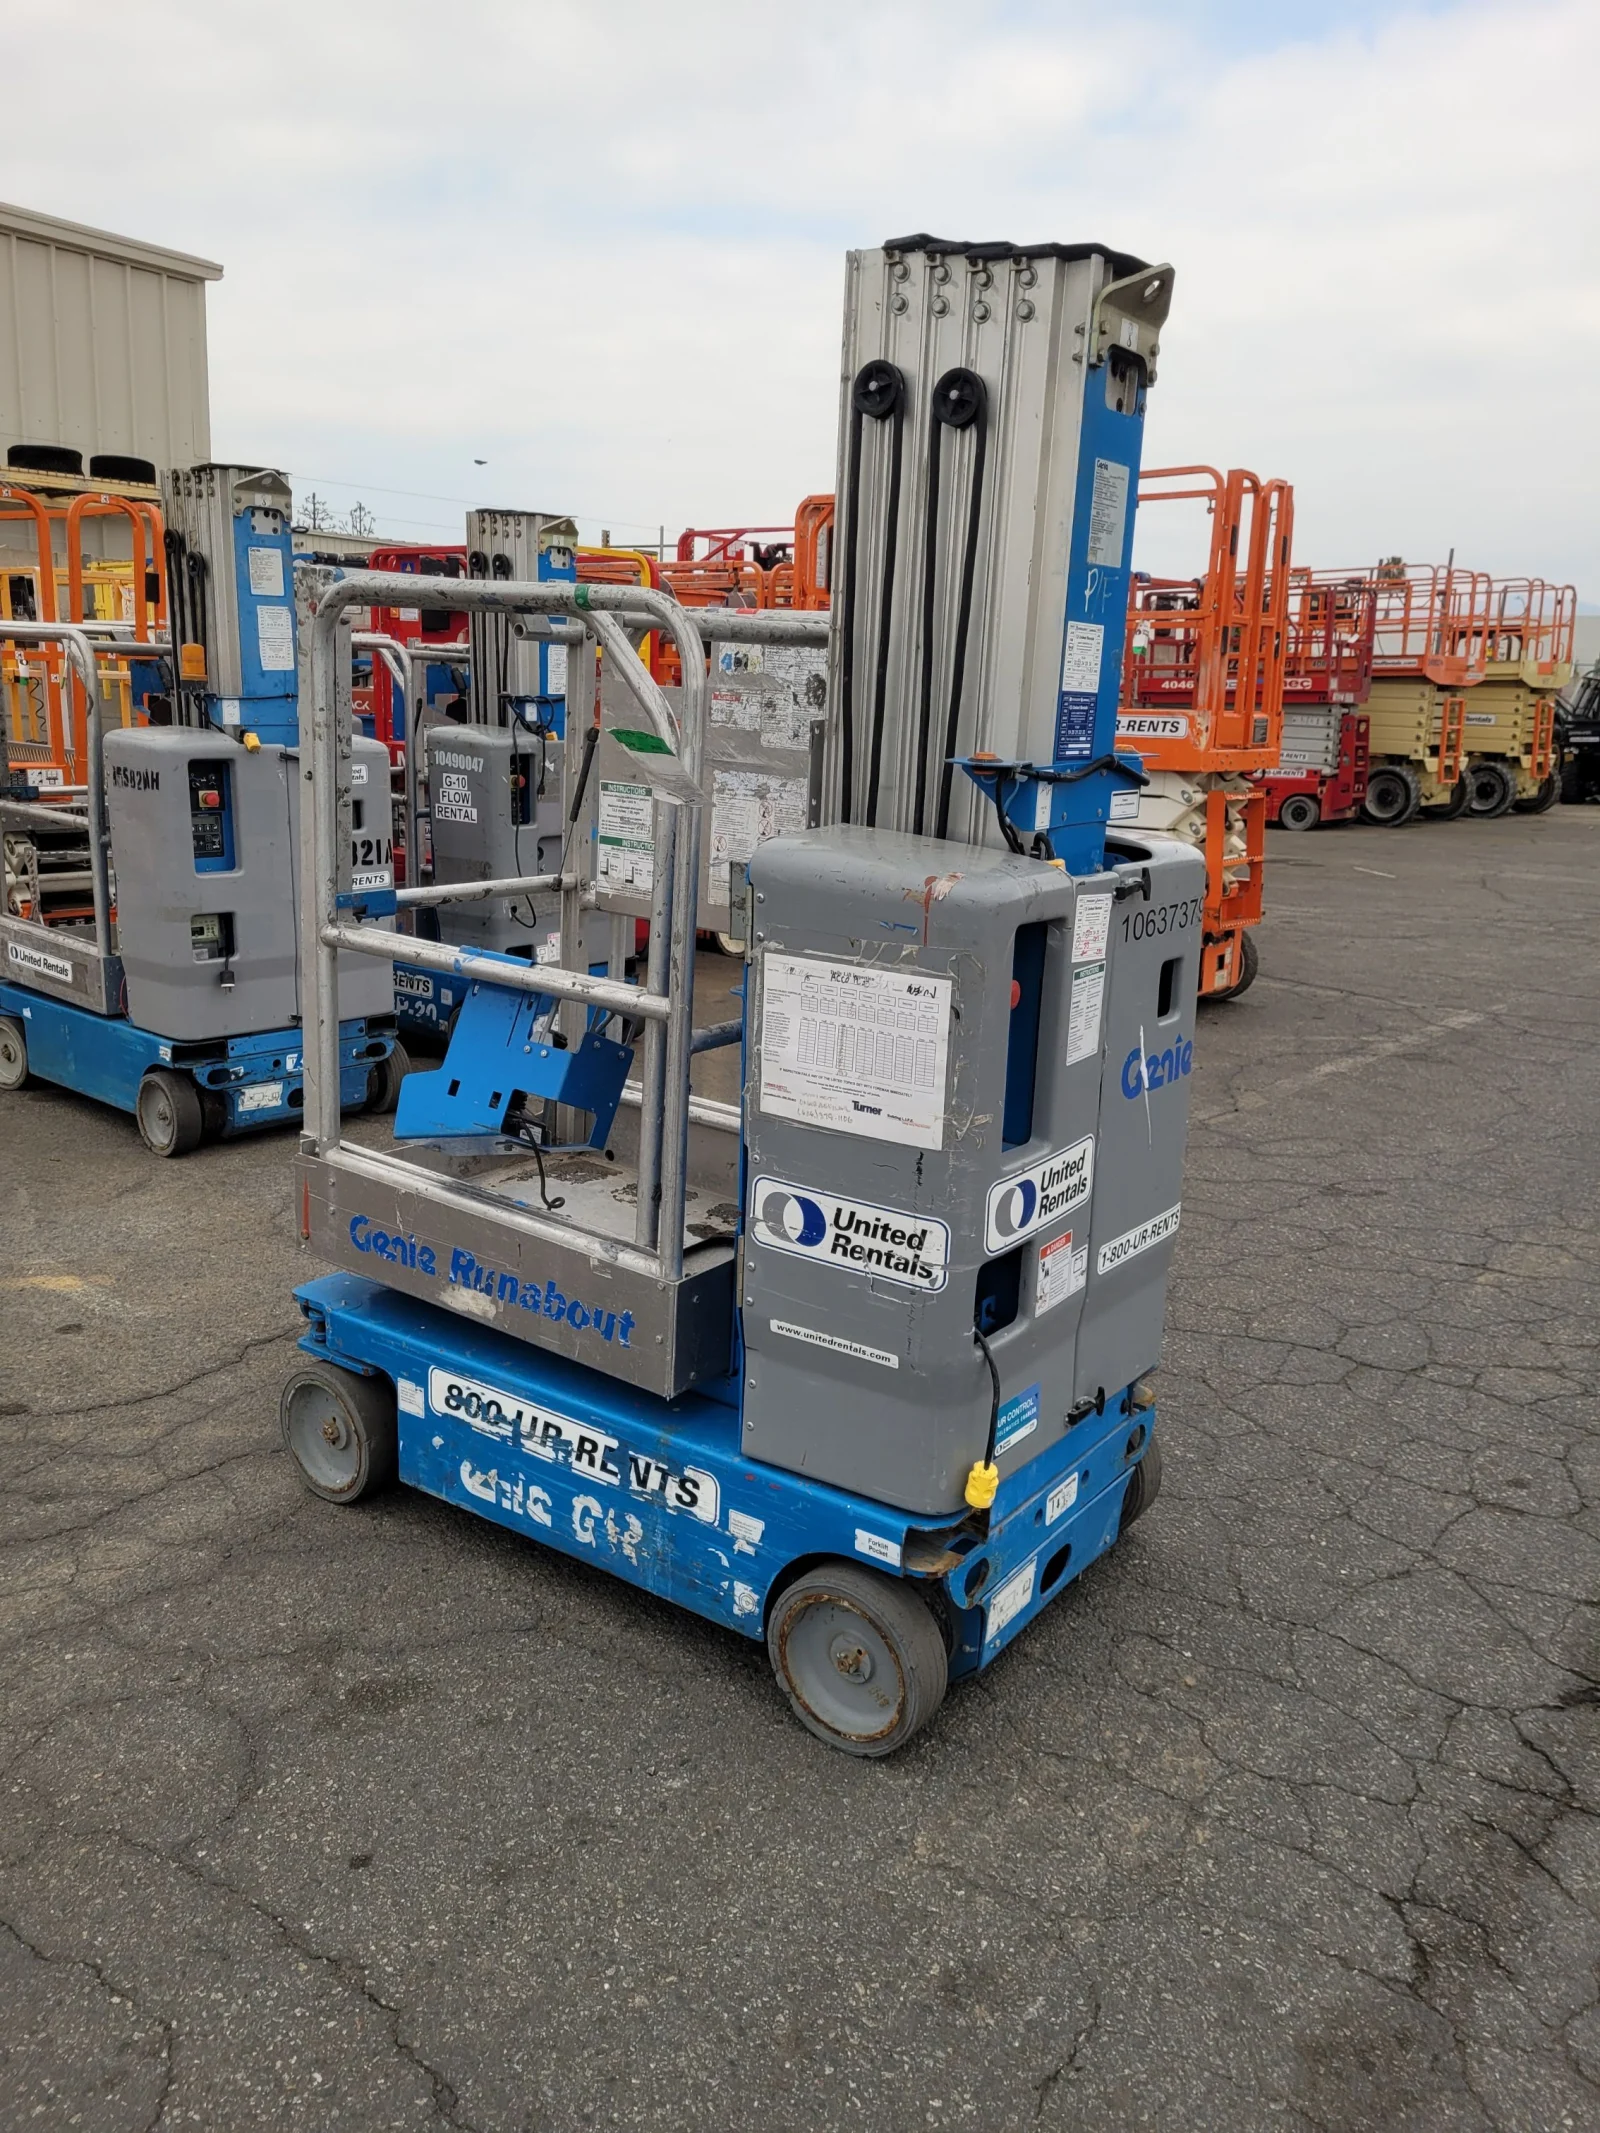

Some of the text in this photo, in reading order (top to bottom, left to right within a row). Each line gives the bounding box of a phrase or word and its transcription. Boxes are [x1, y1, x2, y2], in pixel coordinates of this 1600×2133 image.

[1161, 680, 1195, 689] 4046
[434, 749, 484, 773] 10490047
[445, 775, 467, 788] G-10
[607, 784, 646, 795] INSTRUCTIONS
[441, 790, 471, 804] FLOW
[437, 806, 476, 822] RENTAL
[20, 950, 69, 977] United Rentals
[1122, 1033, 1193, 1099] Genie
[852, 1101, 882, 1115] Turner
[1041, 1149, 1086, 1193] United
[1038, 1174, 1087, 1219] Rentals
[833, 1207, 927, 1251] United
[1102, 1209, 1179, 1267] 1-800-UR-RENTS
[831, 1233, 932, 1280] Rentals
[350, 1214, 635, 1348] Genie Runabout
[777, 1324, 891, 1363] www.unitedrentals.com
[1007, 1398, 1034, 1421] CONTROL
[868, 1538, 888, 1551] Forklift
[869, 1545, 888, 1557] Pocket
